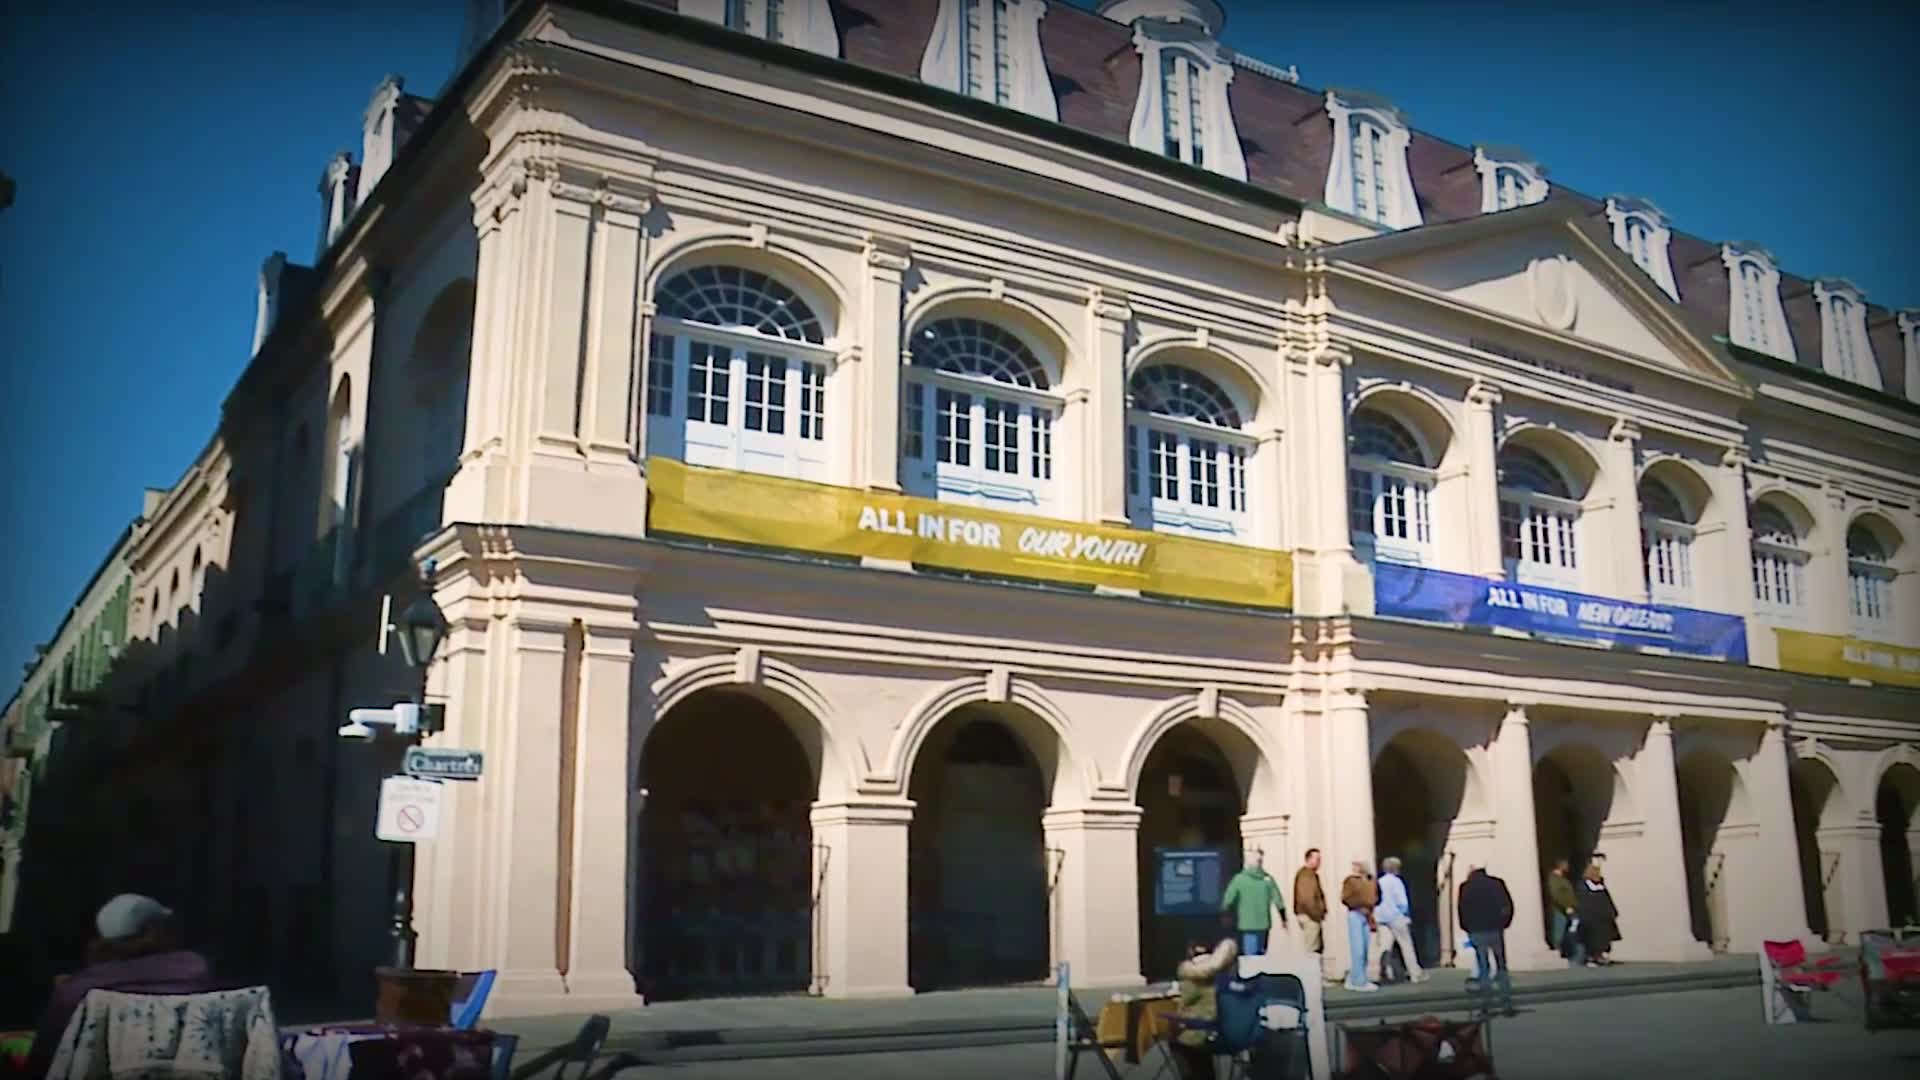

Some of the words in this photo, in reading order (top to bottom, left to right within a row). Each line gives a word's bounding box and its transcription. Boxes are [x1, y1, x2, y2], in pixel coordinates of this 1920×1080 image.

[858, 506, 912, 535] ALL
[918, 512, 944, 541] IN
[950, 518, 1002, 549] FOR
[1018, 526, 1072, 556] OUR
[1069, 533, 1148, 566] YOUTH
[1487, 586, 1521, 608] ALL
[1539, 594, 1570, 617] FOR
[1576, 601, 1612, 624] NEW
